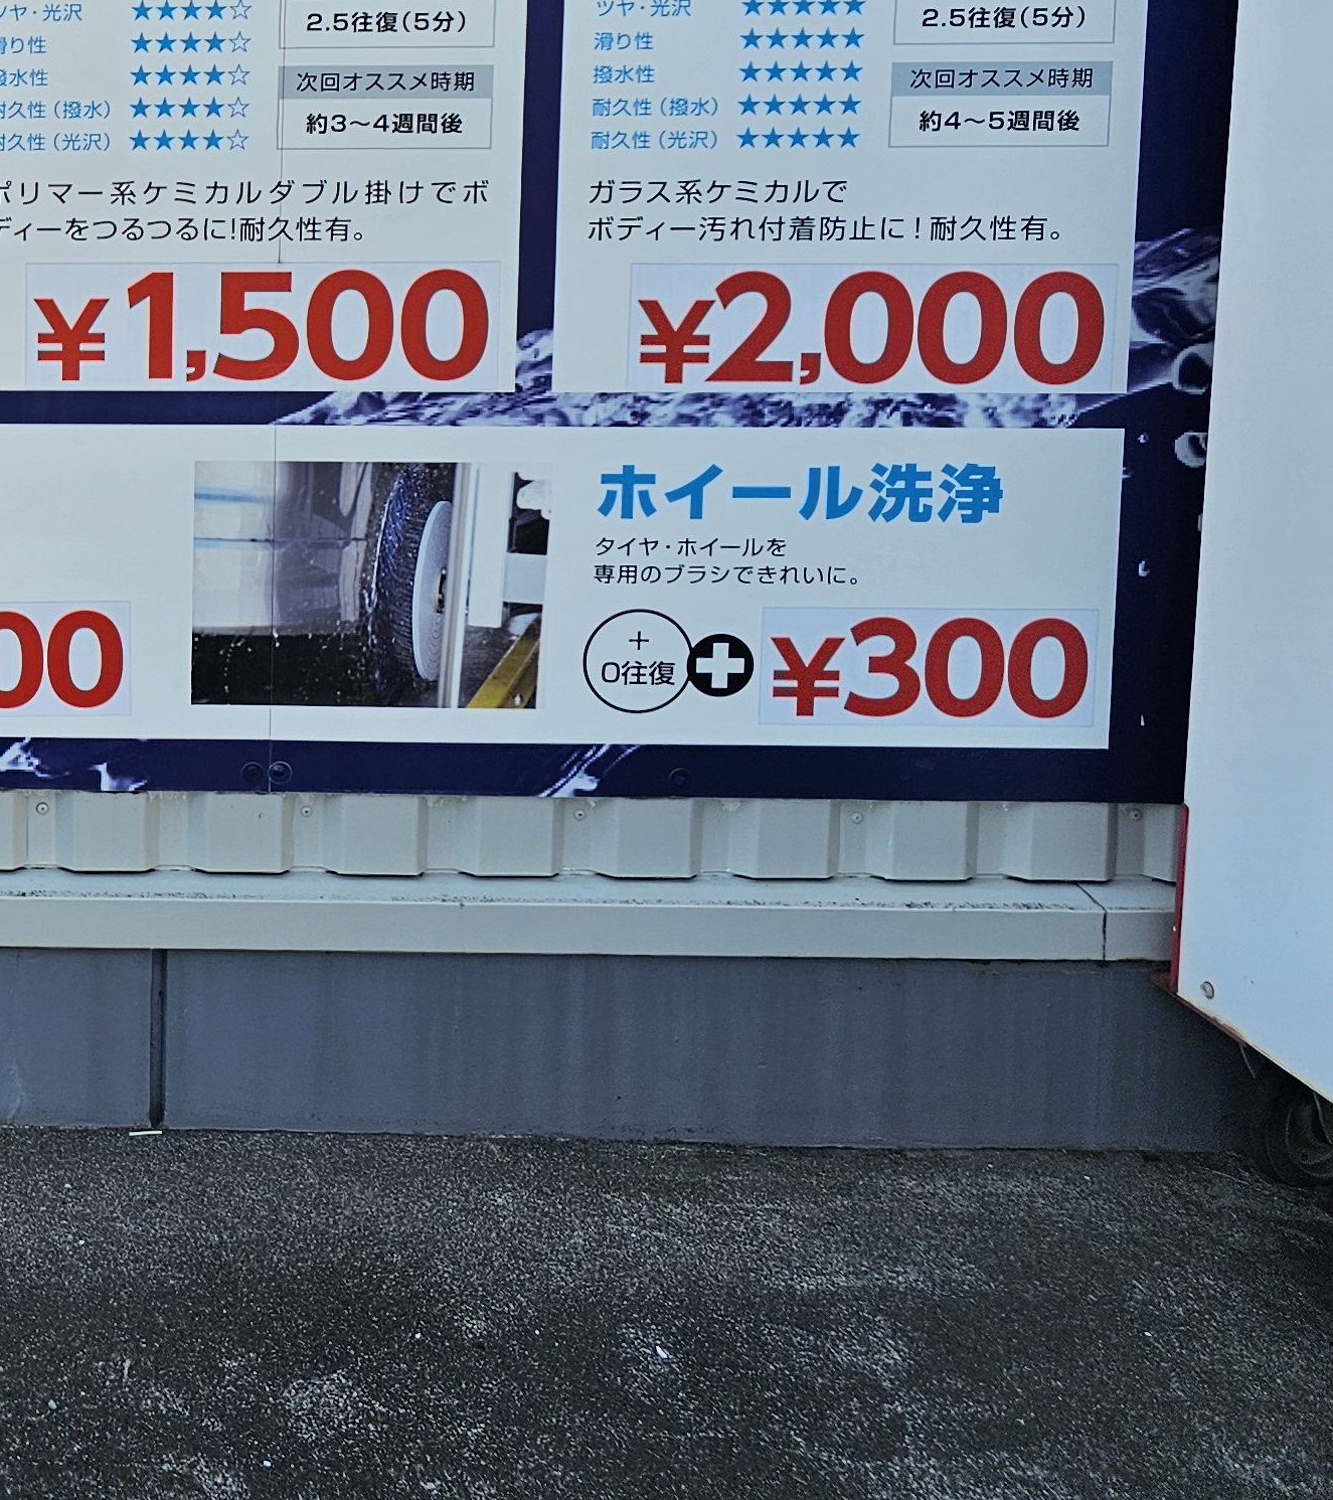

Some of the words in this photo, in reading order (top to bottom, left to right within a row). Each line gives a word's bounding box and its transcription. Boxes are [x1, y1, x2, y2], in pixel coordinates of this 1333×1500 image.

[593, 31, 654, 51] 滑り性
[296, 71, 475, 93] 次回オススメ時期
[593, 64, 655, 84] 撥水性
[910, 67, 1094, 89] 次回オススメ時期
[589, 178, 848, 205] ガラス系ケミカルで
[33, 268, 490, 382] ¥1,500
[637, 270, 1105, 386] ¥2,000
[596, 462, 1004, 524] ホイール洗浄
[593, 564, 858, 585] 専用のブラシできれいに。
[770, 616, 1089, 719] ¥300
